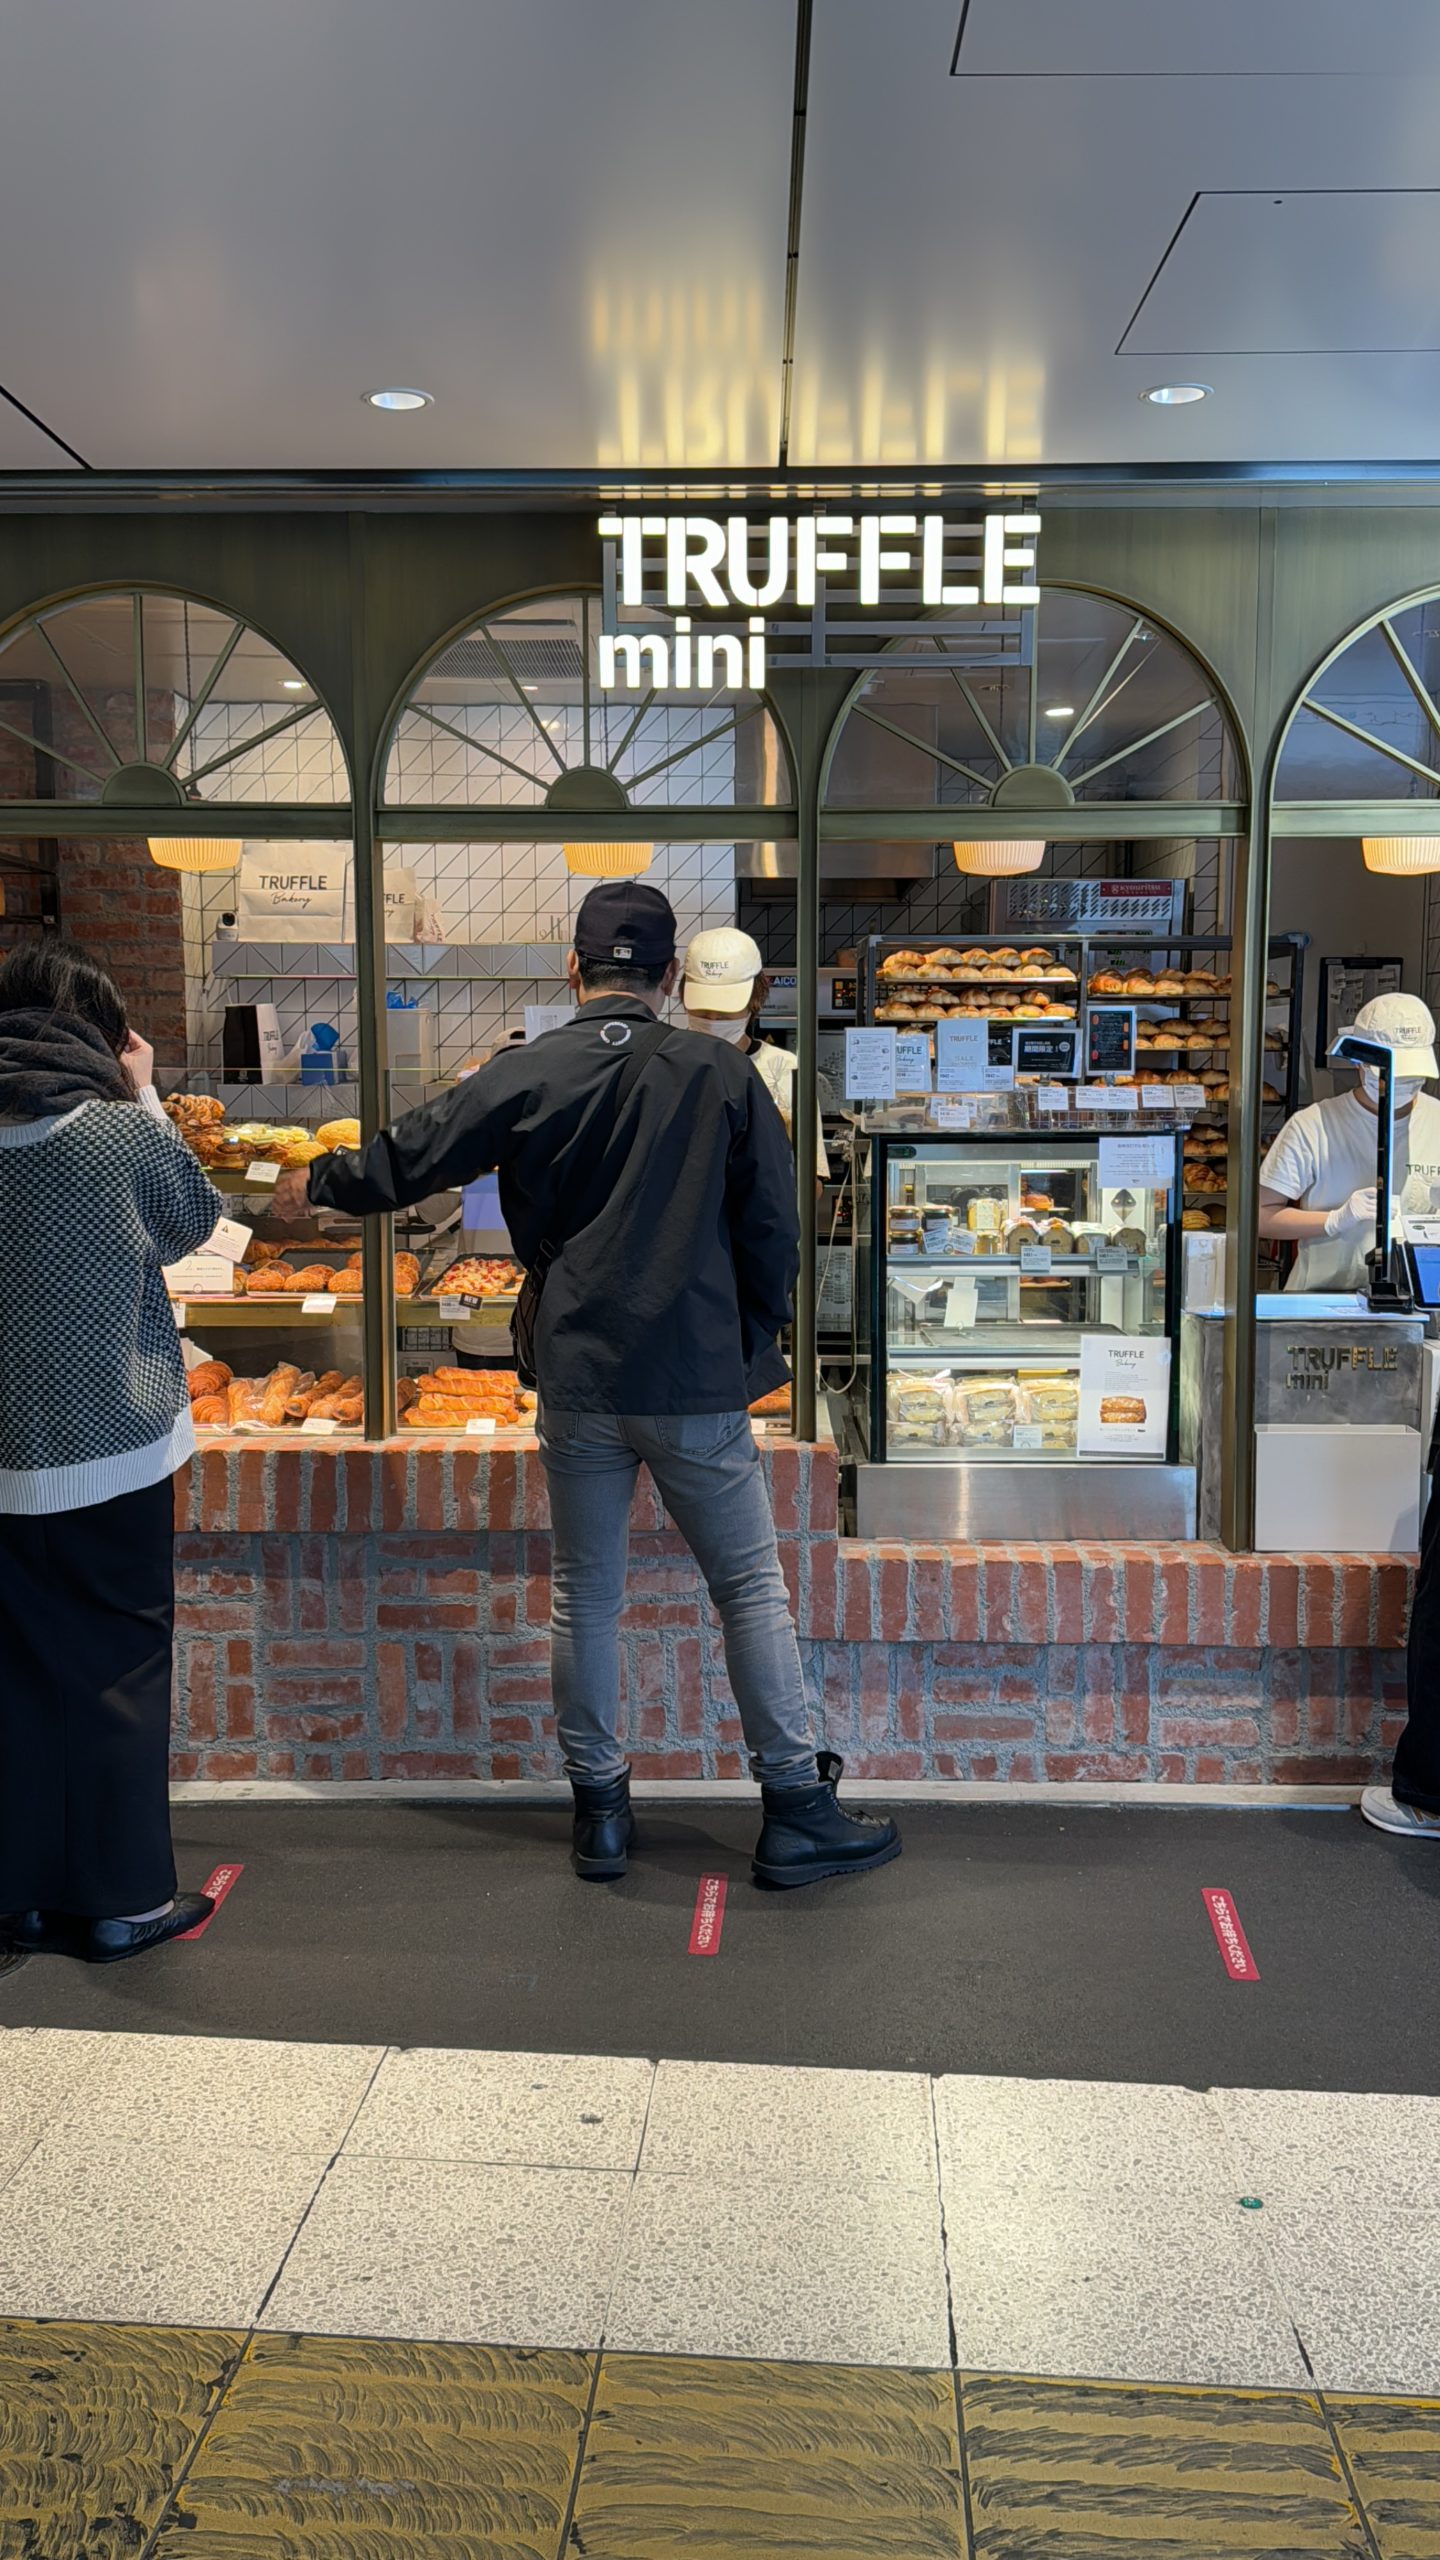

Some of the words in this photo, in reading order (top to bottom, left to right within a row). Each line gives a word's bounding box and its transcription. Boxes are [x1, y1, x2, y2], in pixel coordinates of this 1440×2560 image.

[598, 515, 1041, 607] TRUFFLE
[599, 616, 766, 689] mini
[258, 875, 328, 891] TRUFFLE
[270, 891, 313, 909] Bakery
[700, 960, 729, 970] TRUFFLE
[1394, 1026, 1422, 1035] TRUFFLE
[463, 1295, 479, 1305] NEW
[1108, 1349, 1145, 1359] TRUFFLE
[1287, 1346, 1399, 1371] TRUFFLE
[1285, 1370, 1329, 1390] mini
[697, 1878, 720, 1948] こちらでお待ちください
[1211, 1895, 1248, 1973] こちらでお待ちください
